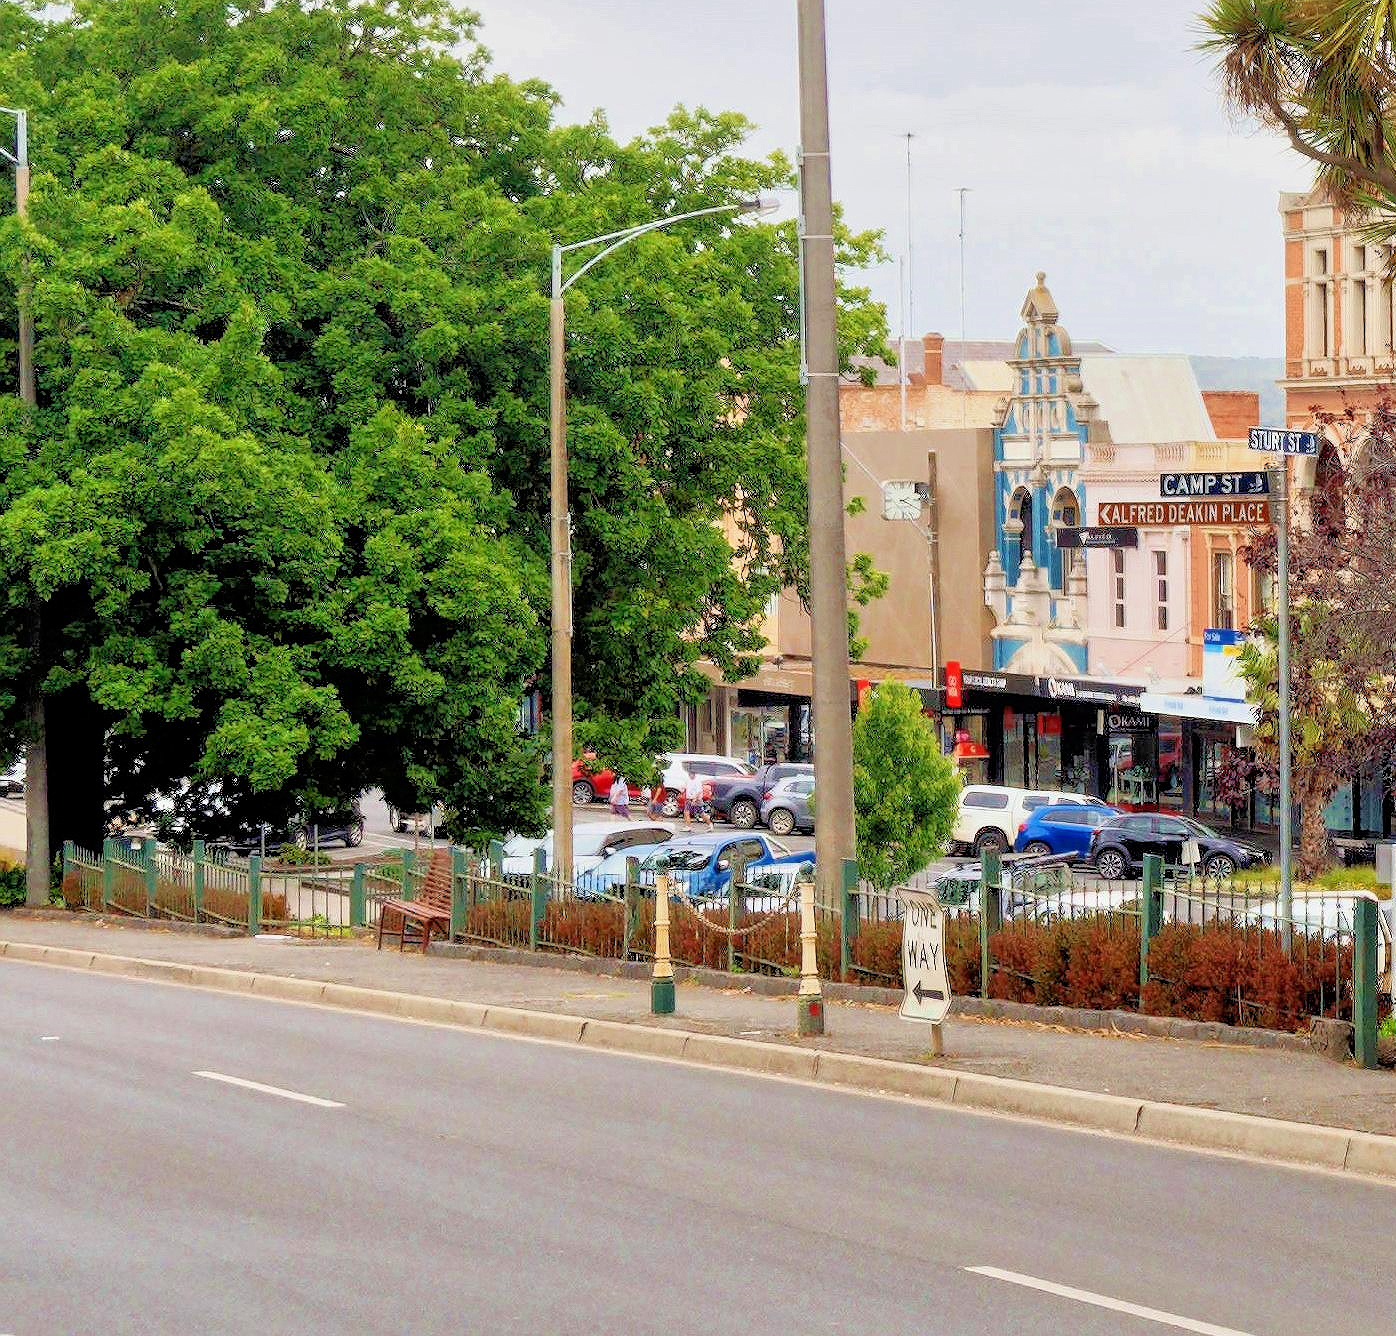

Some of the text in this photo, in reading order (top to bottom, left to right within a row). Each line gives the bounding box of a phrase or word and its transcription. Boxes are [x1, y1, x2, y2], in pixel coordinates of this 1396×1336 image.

[1250, 429, 1302, 453] STURT ST
[1163, 474, 1243, 495] CAMP ST
[1111, 503, 1264, 524] ALFRED DEAKIN PLACE
[909, 900, 937, 929] ONE
[907, 939, 939, 971] WAY
